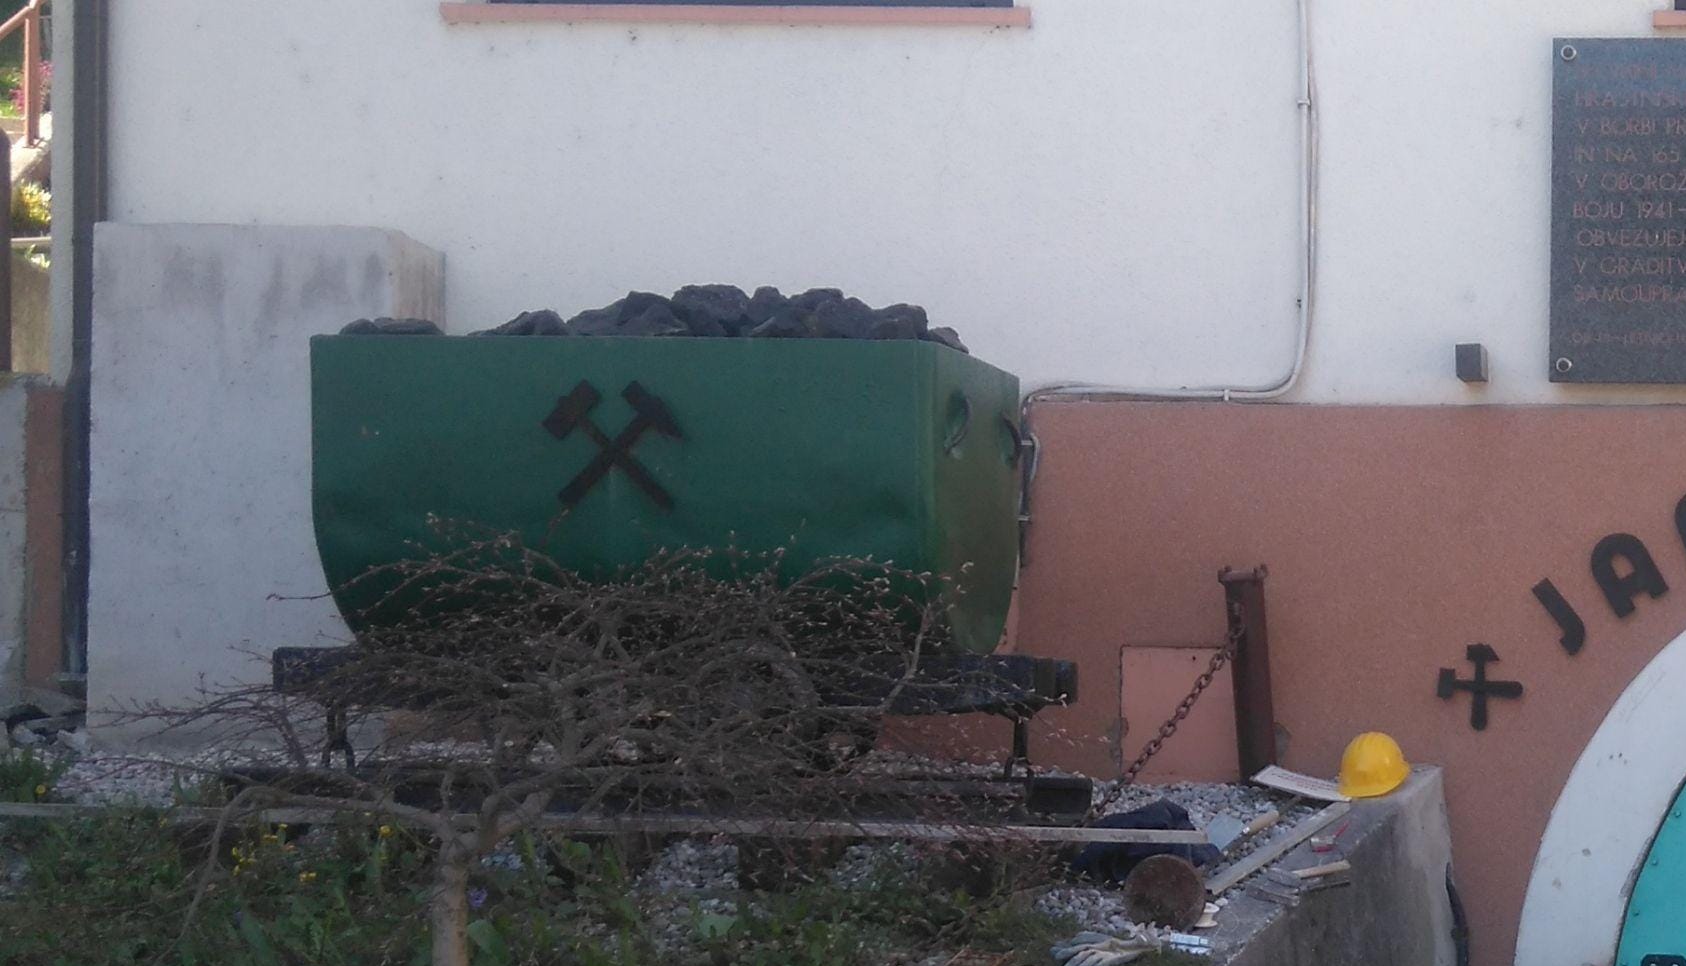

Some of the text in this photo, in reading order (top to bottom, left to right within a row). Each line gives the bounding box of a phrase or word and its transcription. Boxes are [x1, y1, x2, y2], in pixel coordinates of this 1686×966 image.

[1576, 118, 1588, 135] V
[1600, 118, 1656, 135] BORBI
[1605, 146, 1637, 163] NA
[1575, 174, 1587, 191] V
[1572, 202, 1624, 219] BOJU
[1573, 258, 1584, 274] V
